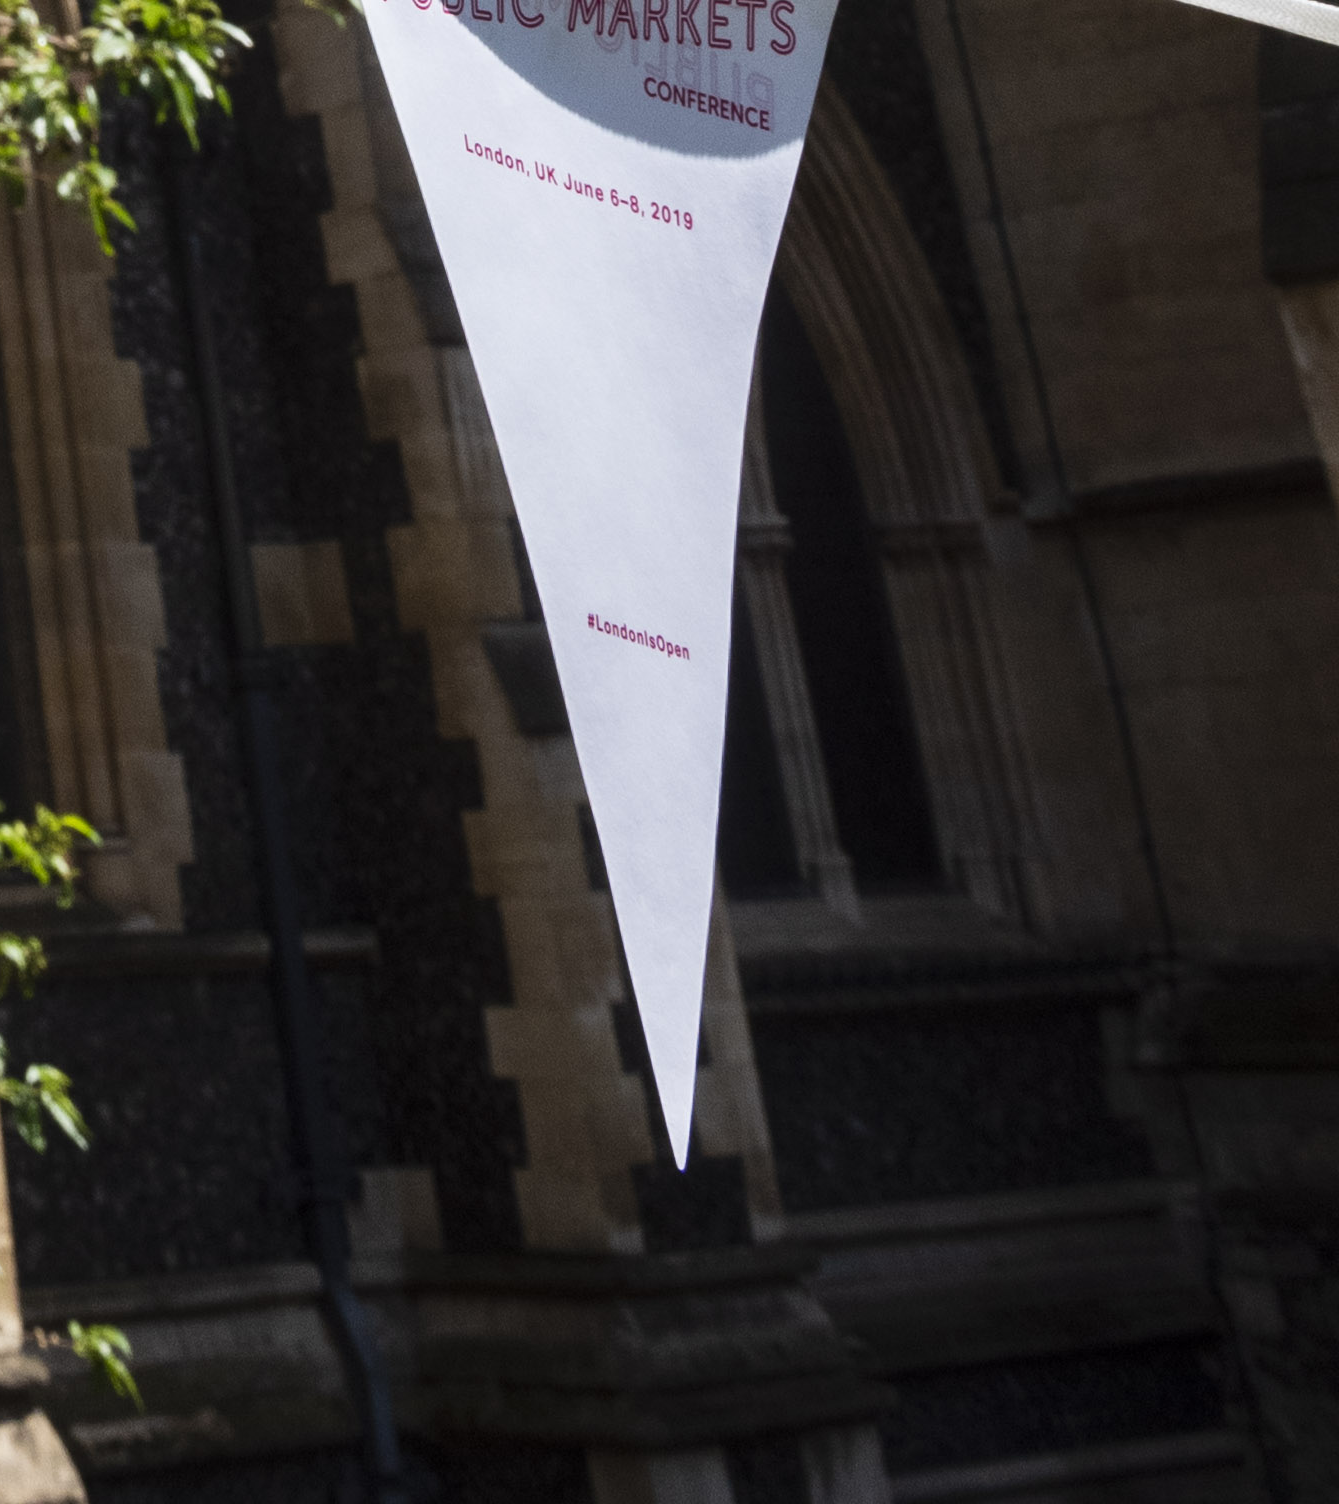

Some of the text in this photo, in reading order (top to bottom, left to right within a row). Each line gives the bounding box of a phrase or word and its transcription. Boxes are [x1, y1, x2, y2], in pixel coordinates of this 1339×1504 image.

[642, 76, 772, 131] CONFERENCE
[464, 133, 530, 177] London,
[534, 160, 559, 186] UK
[563, 173, 605, 202] June
[650, 201, 694, 230] 2019
[587, 612, 691, 661] #LondonIsOpen
